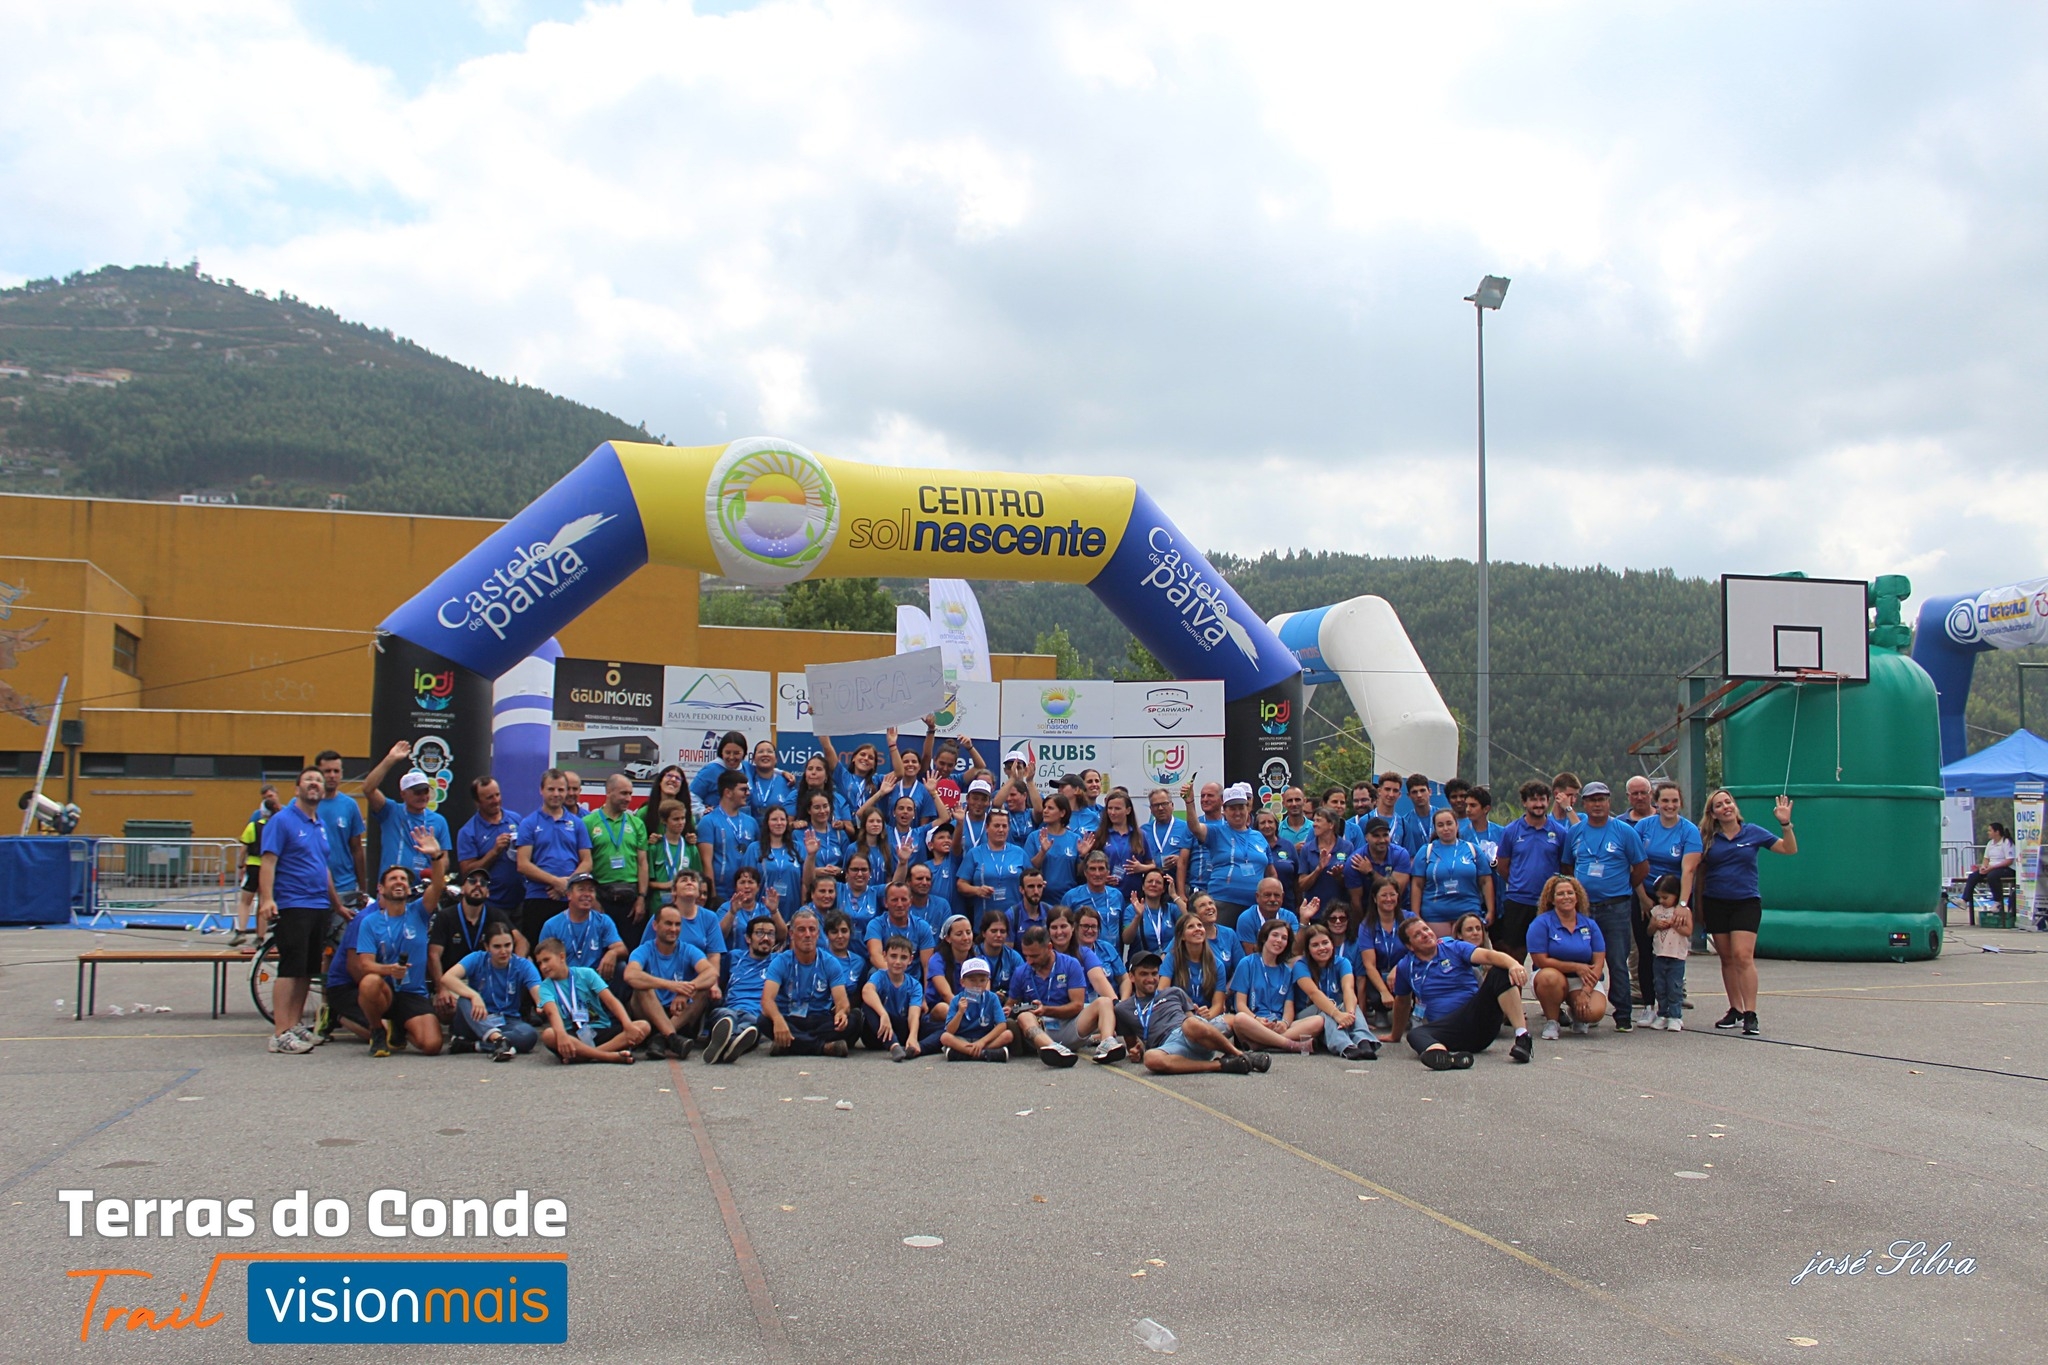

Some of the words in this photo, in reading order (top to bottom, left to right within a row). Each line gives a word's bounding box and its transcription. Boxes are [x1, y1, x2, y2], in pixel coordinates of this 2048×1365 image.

[918, 485, 1044, 518] CENTRO
[1148, 552, 1161, 566] de
[1148, 526, 1228, 617] Castelo
[437, 541, 551, 629] Castelo
[468, 617, 484, 631] de
[480, 546, 584, 641] paiva
[1140, 562, 1227, 647] paiva
[414, 668, 454, 697] ipdj
[811, 671, 912, 716] FORÇA
[668, 711, 691, 720] RAIVA
[692, 713, 734, 721] PEDORIDO
[1260, 699, 1290, 723] ipdj
[1038, 762, 1065, 778] GÁS
[1147, 744, 1185, 770] ipdj
[937, 786, 959, 799] STOP
[2016, 811, 2036, 822] ONDE
